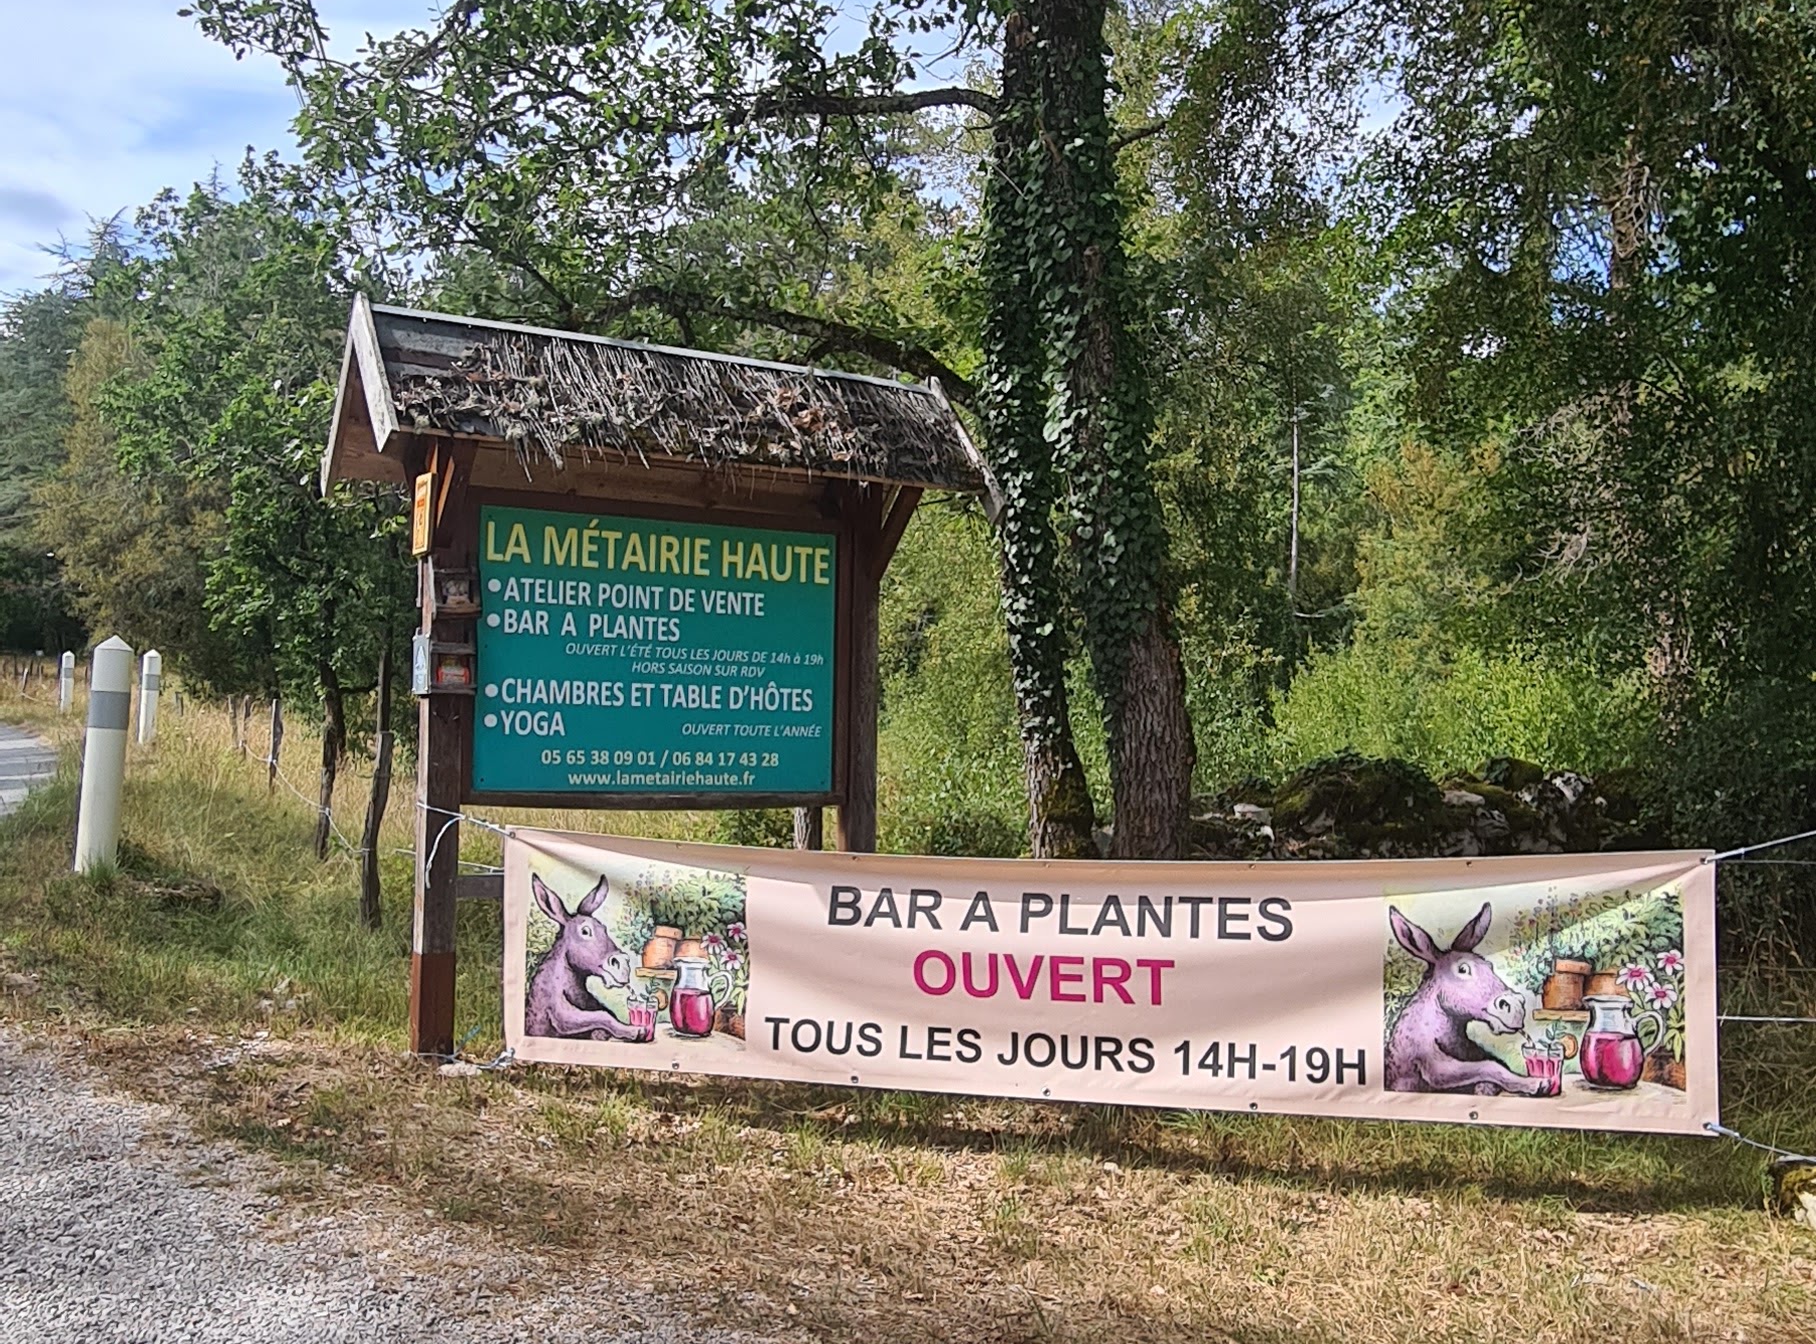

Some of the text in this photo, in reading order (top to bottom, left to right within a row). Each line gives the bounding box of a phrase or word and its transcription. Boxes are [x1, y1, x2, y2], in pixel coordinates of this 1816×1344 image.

[486, 518, 830, 585] LA MÉTAIRIE HAUTE
[503, 576, 765, 617] ATELIER POINT DE VENTE
[503, 608, 680, 642] BAR A PLANTES
[565, 642, 618, 657] OUVERT
[619, 642, 653, 659] L'ÉTÉ
[655, 646, 688, 660] TOUS
[689, 648, 710, 661] LES
[711, 649, 750, 663] JOURS
[751, 651, 768, 663] DE
[769, 652, 791, 664] 14h
[803, 653, 824, 666] 19h
[631, 661, 766, 678] HORS SAISON SUR RDV
[501, 677, 813, 712] CHAMBRES ET TABLE D'HÔTES
[500, 709, 566, 737] YOGA
[681, 723, 822, 738] OUVERT TOUTE L'ANNÉE
[541, 749, 562, 765] 05
[566, 749, 585, 765] 65
[590, 750, 608, 765] 38
[613, 750, 632, 766] 09
[637, 750, 656, 766] 01
[672, 751, 692, 766] 06
[694, 751, 714, 766] 84
[718, 751, 736, 767] 17
[738, 752, 758, 767] 43
[761, 752, 779, 767] 28
[567, 766, 756, 786] www.lametairiehaute.fr
[828, 885, 1297, 941] BAR A PLANTES
[913, 950, 1173, 1005] OUVERT
[765, 1017, 1366, 1085] TOUS LES JOURS 14H-19H
